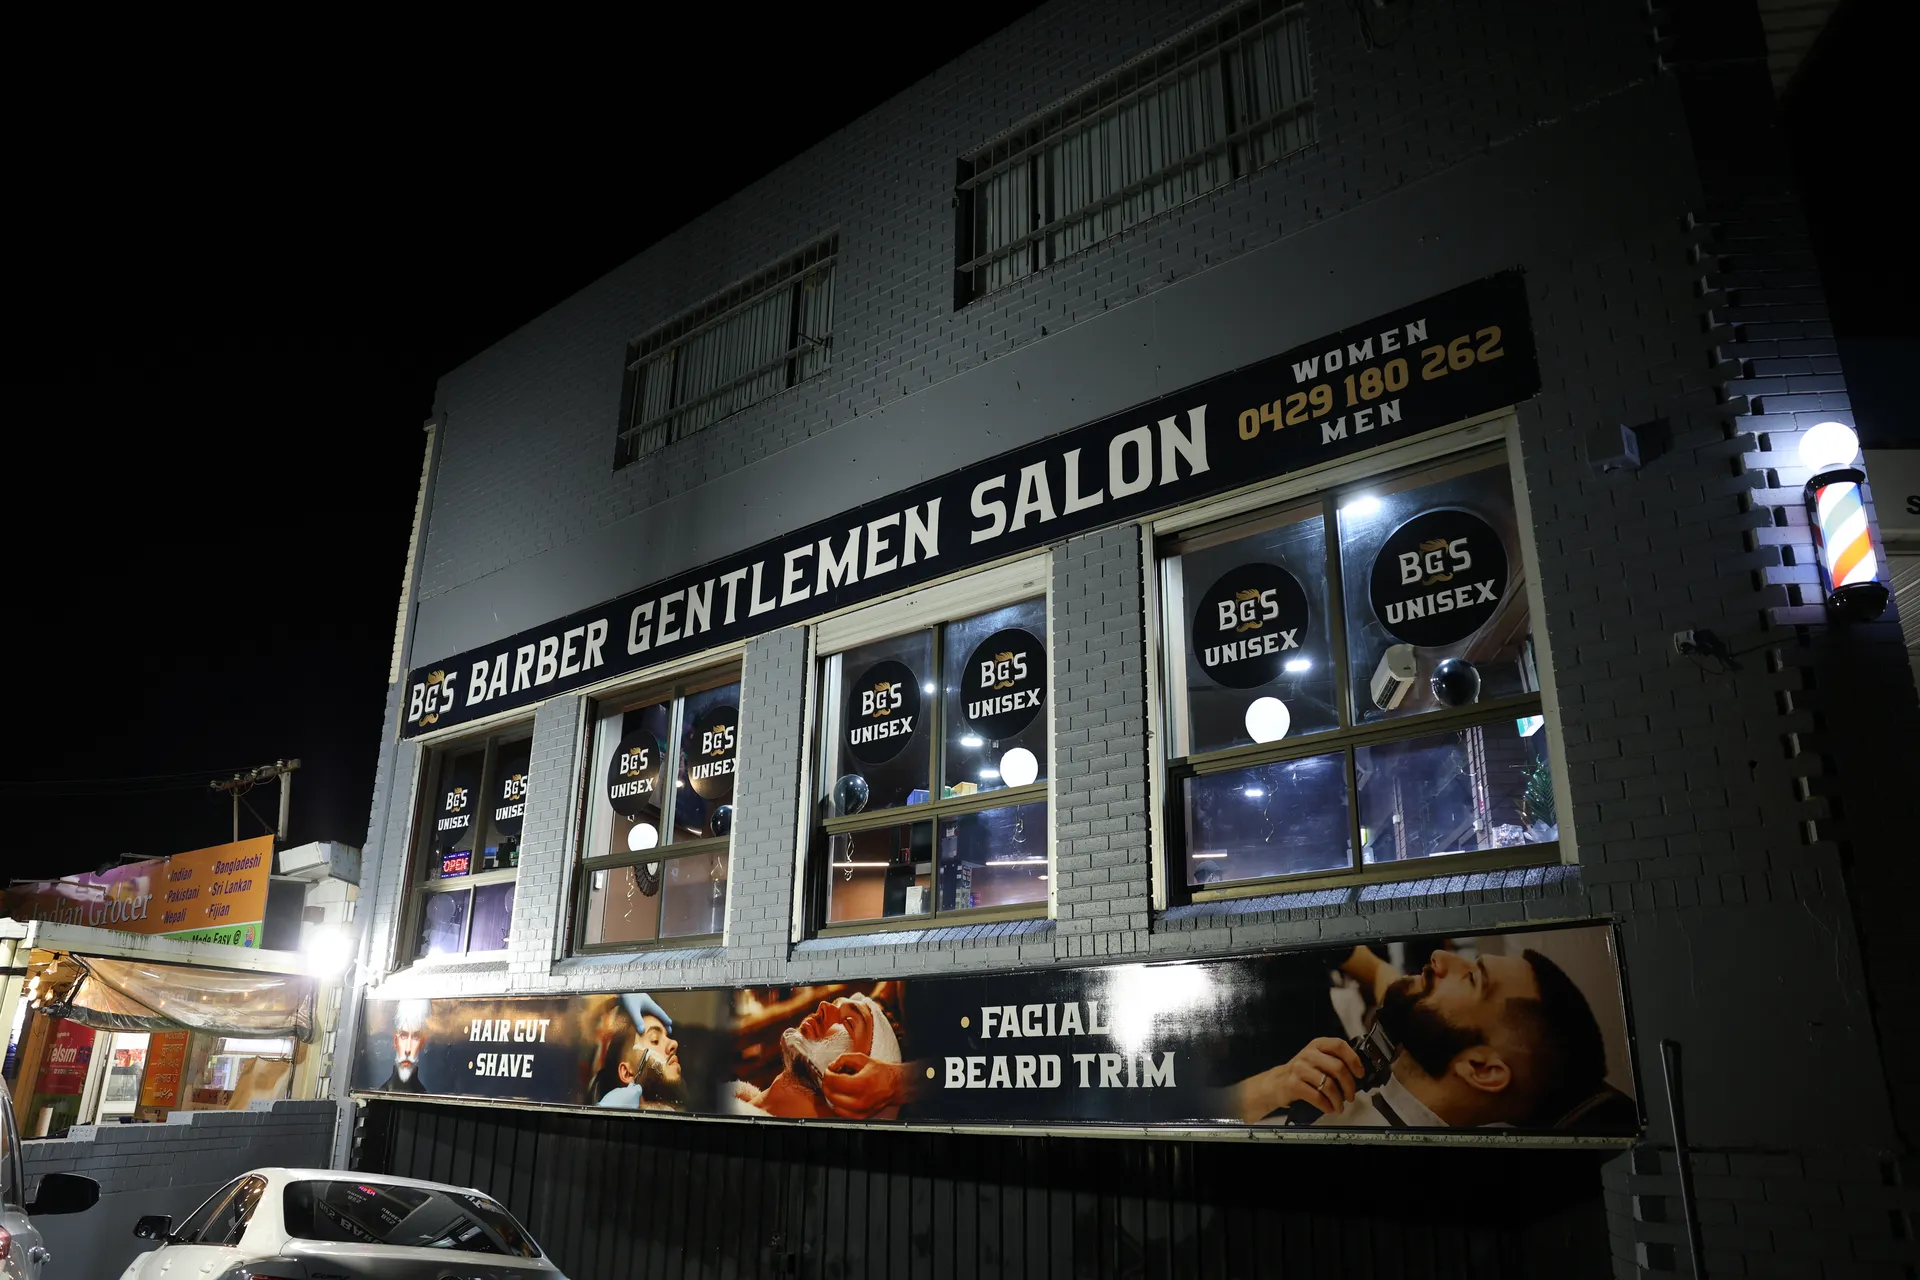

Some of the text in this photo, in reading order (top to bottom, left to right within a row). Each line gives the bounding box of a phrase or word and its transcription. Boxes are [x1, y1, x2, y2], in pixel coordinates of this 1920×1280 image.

[1291, 318, 1429, 384] WOMEN
[1238, 325, 1505, 441] 0429 180 262
[1320, 399, 1403, 445] MEN
[408, 404, 1211, 723] BGS BARBER GENTLEMEN SALON
[1398, 537, 1473, 586] BGS
[1217, 588, 1280, 631] BGS
[1384, 578, 1498, 625] UNISEX
[1204, 627, 1300, 668] UNISEX
[980, 652, 1028, 688] BGS
[861, 682, 903, 716] BGS
[968, 687, 1041, 720] UNISEX
[701, 726, 735, 755] BGS
[850, 715, 914, 746] UNISEX
[619, 747, 650, 776] BGS
[446, 789, 468, 811] BGS
[503, 775, 528, 800] BGS
[610, 777, 654, 800] UNISEX
[438, 814, 470, 832] UNISEX
[170, 867, 193, 882] Indian
[215, 852, 263, 875] Bangladeshi
[442, 857, 469, 873] OPEN
[167, 885, 200, 903] Pakistani
[211, 877, 253, 897] Sri Lankan
[89, 892, 153, 927] Grocer
[163, 908, 187, 924] Nepali
[208, 903, 231, 920] Fijian
[469, 1019, 550, 1043] HAIR CUT
[980, 1000, 1110, 1039] FACIAL
[46, 1043, 78, 1064] Telsim
[475, 1053, 535, 1079] SHAVE
[944, 1051, 1177, 1089] BEARD TRIM
